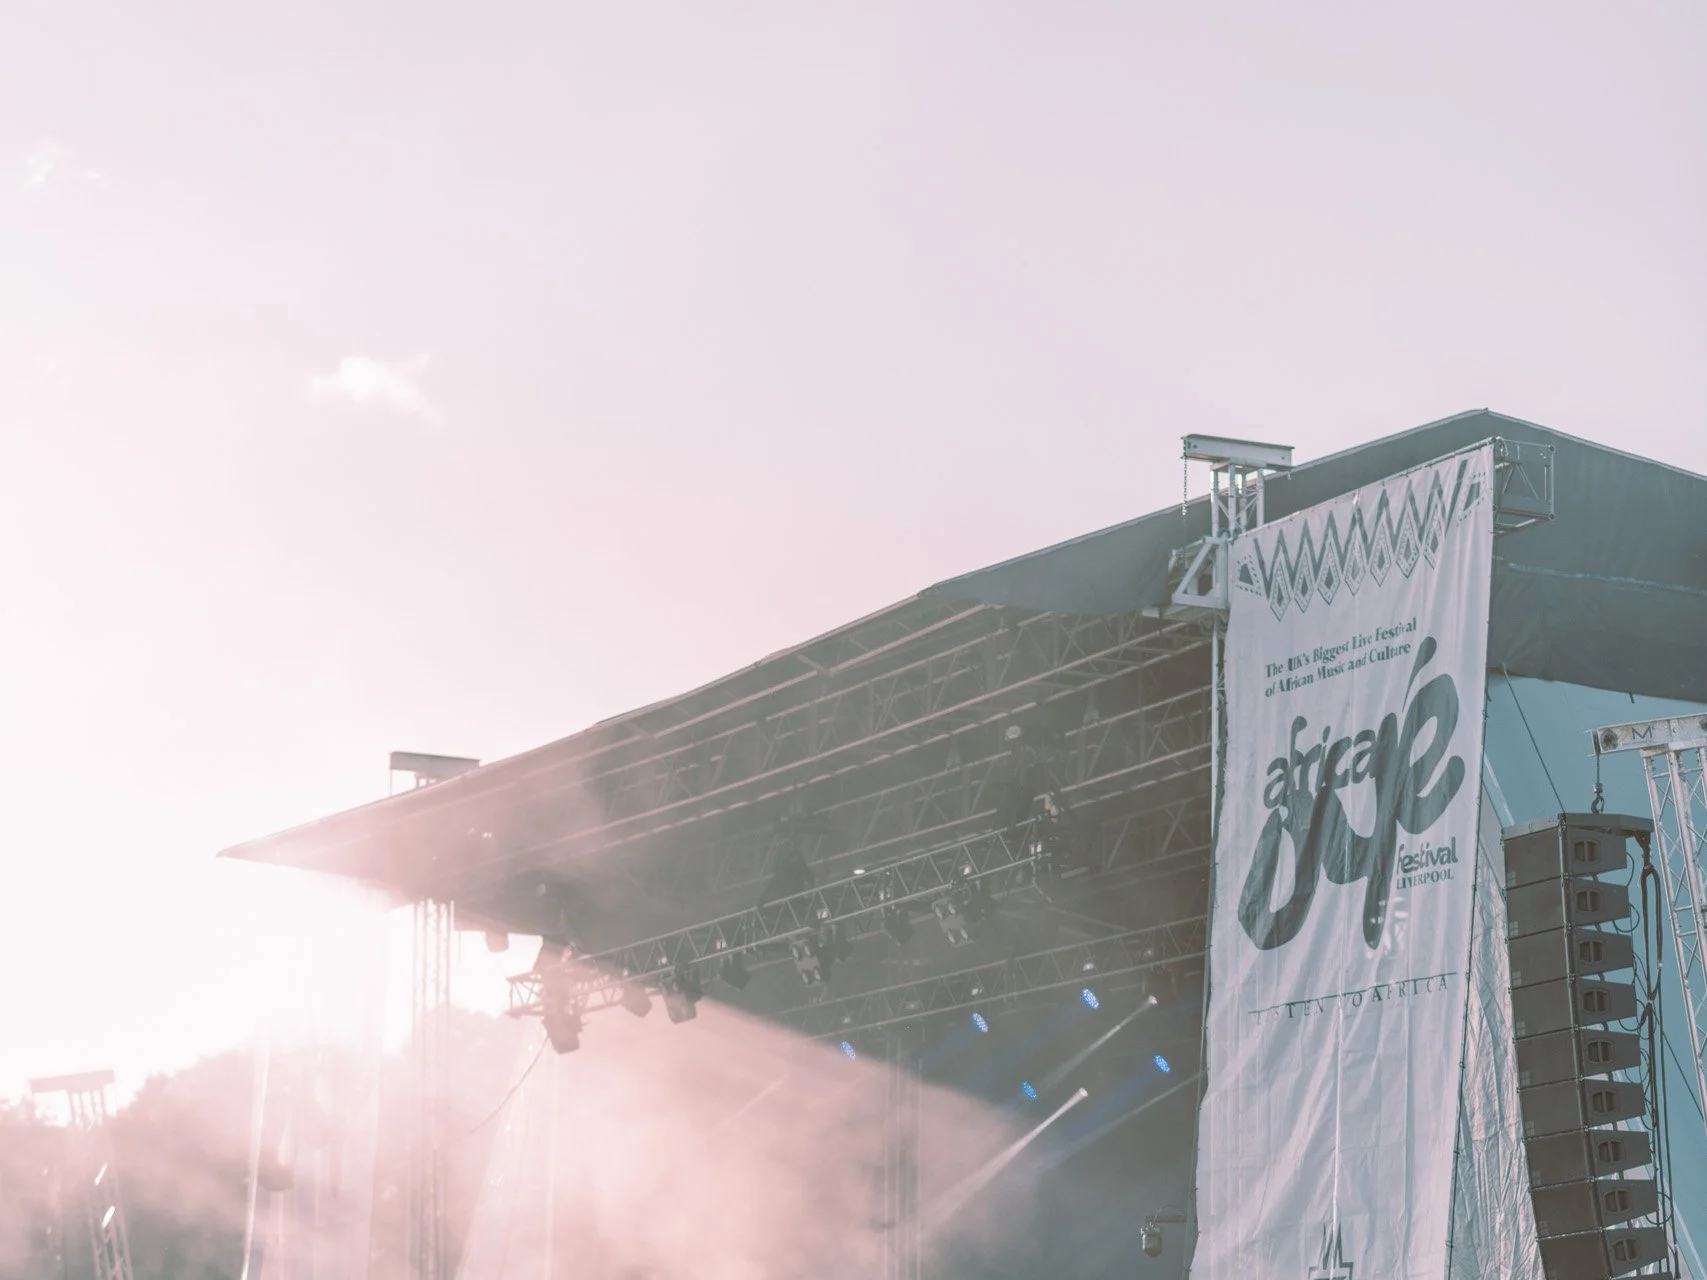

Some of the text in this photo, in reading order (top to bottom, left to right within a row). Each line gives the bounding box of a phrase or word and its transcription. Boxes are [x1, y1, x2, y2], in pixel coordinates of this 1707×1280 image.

[1265, 617, 1416, 679] The UK's Biggest Live Festival
[1265, 643, 1412, 698] of African Music and Culture
[1396, 836, 1459, 875] festival
[1396, 868, 1455, 890] LIVERPOOL
[1371, 974, 1449, 1003] AFRICA
